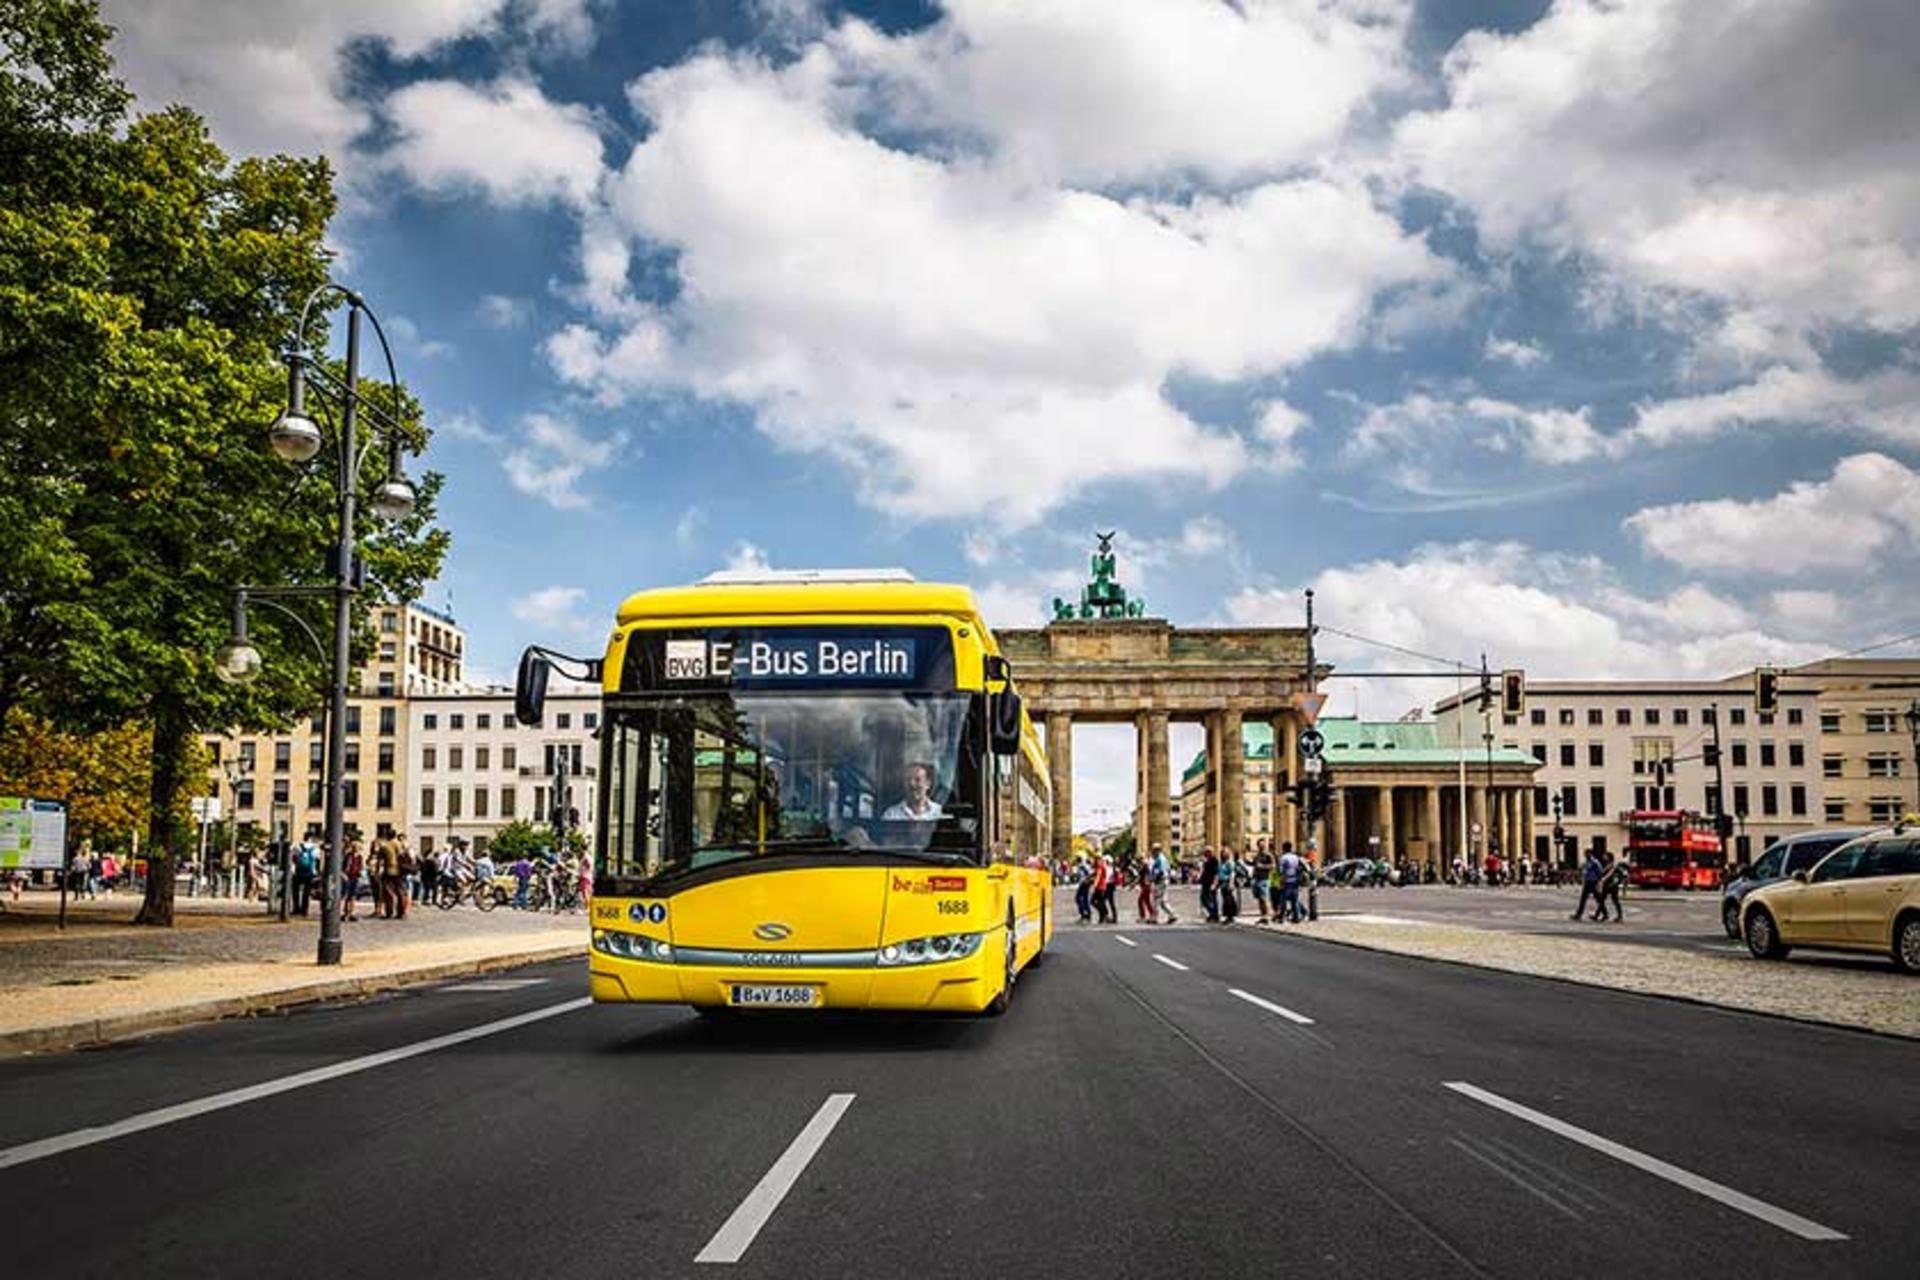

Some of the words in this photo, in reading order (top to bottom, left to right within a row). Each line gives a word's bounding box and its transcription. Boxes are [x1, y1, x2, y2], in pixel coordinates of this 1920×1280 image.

[711, 642, 808, 675] E-Bus
[818, 640, 907, 675] Berlin
[668, 657, 704, 676] BVG
[938, 900, 969, 915] 1688
[775, 988, 810, 1002] 1688
